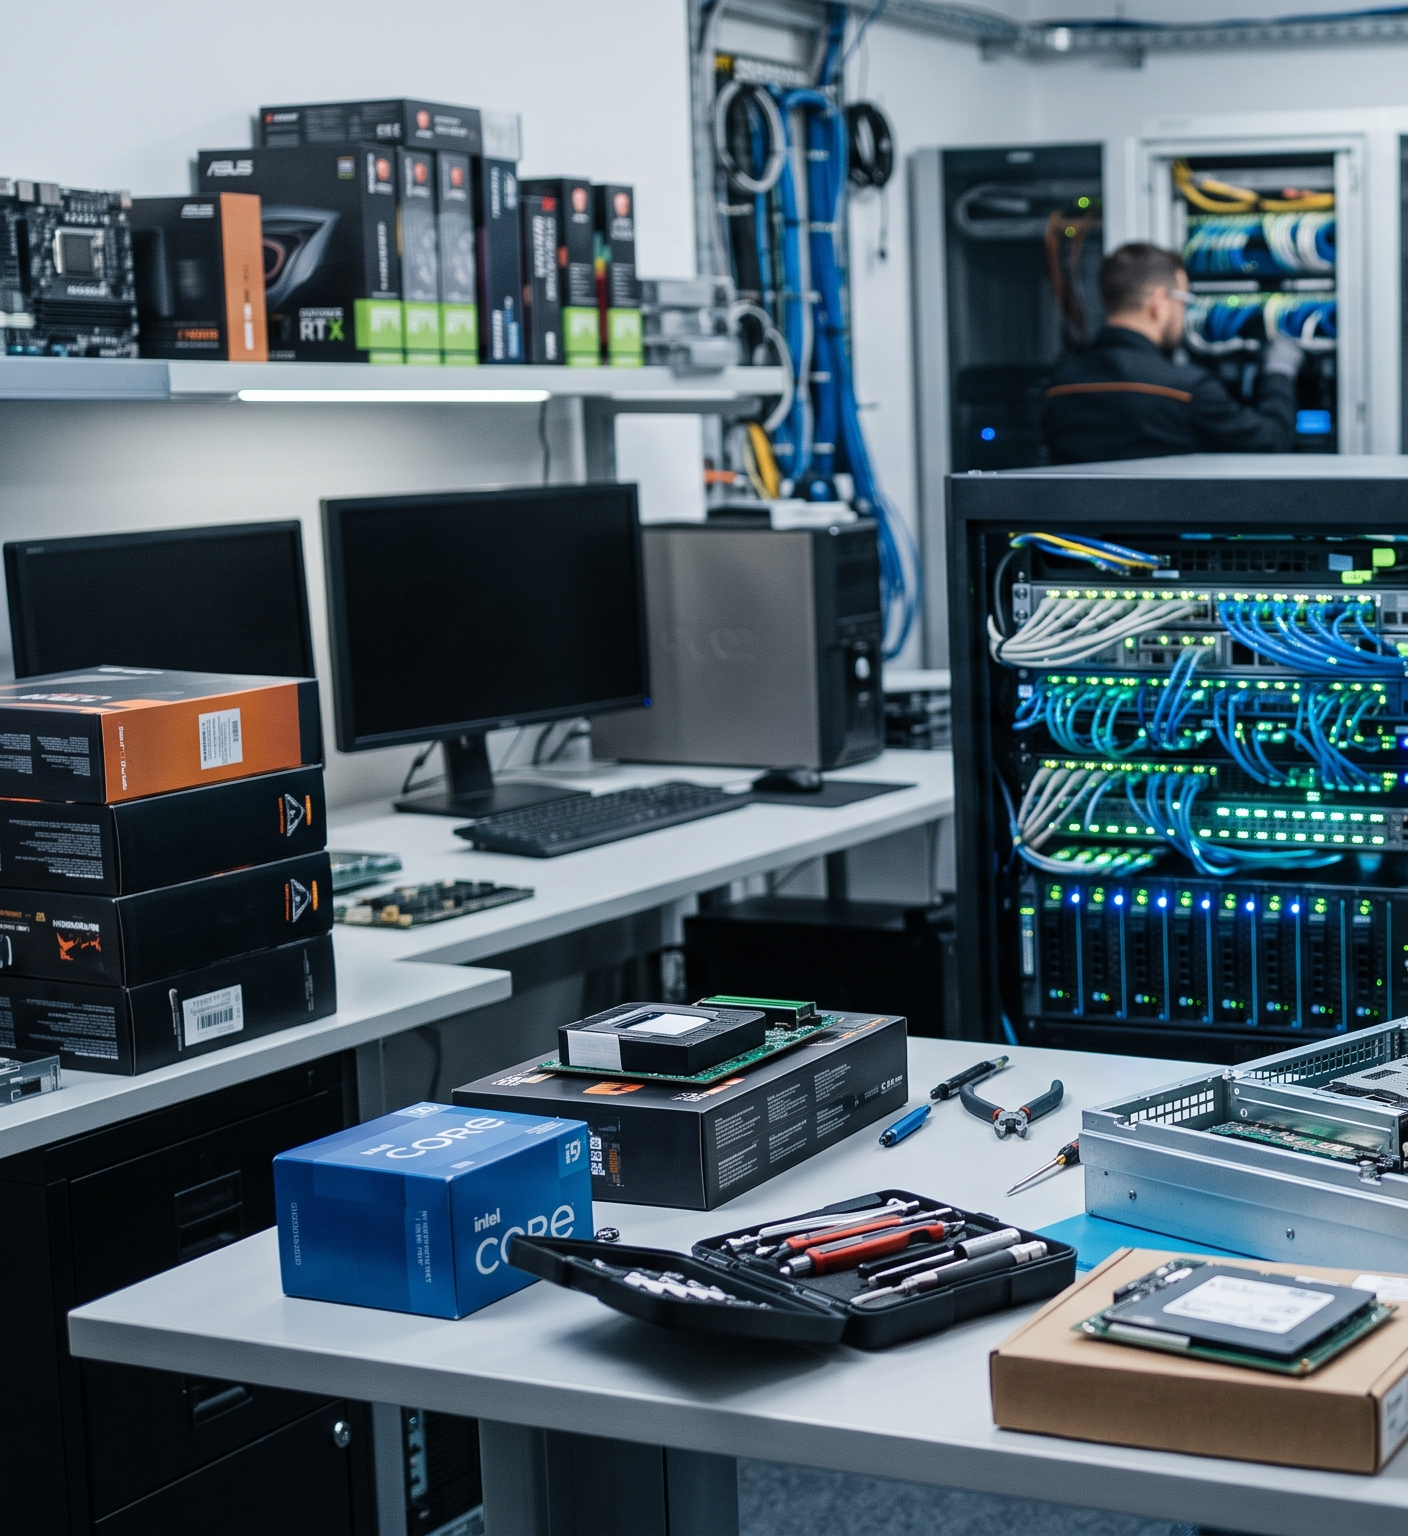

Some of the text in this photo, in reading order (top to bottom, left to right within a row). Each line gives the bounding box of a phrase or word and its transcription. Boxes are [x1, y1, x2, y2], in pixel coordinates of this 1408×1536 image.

[206, 159, 254, 177] ASUS
[300, 318, 345, 342] RTX
[564, 1138, 581, 1165] i9
[473, 1207, 502, 1234] intel
